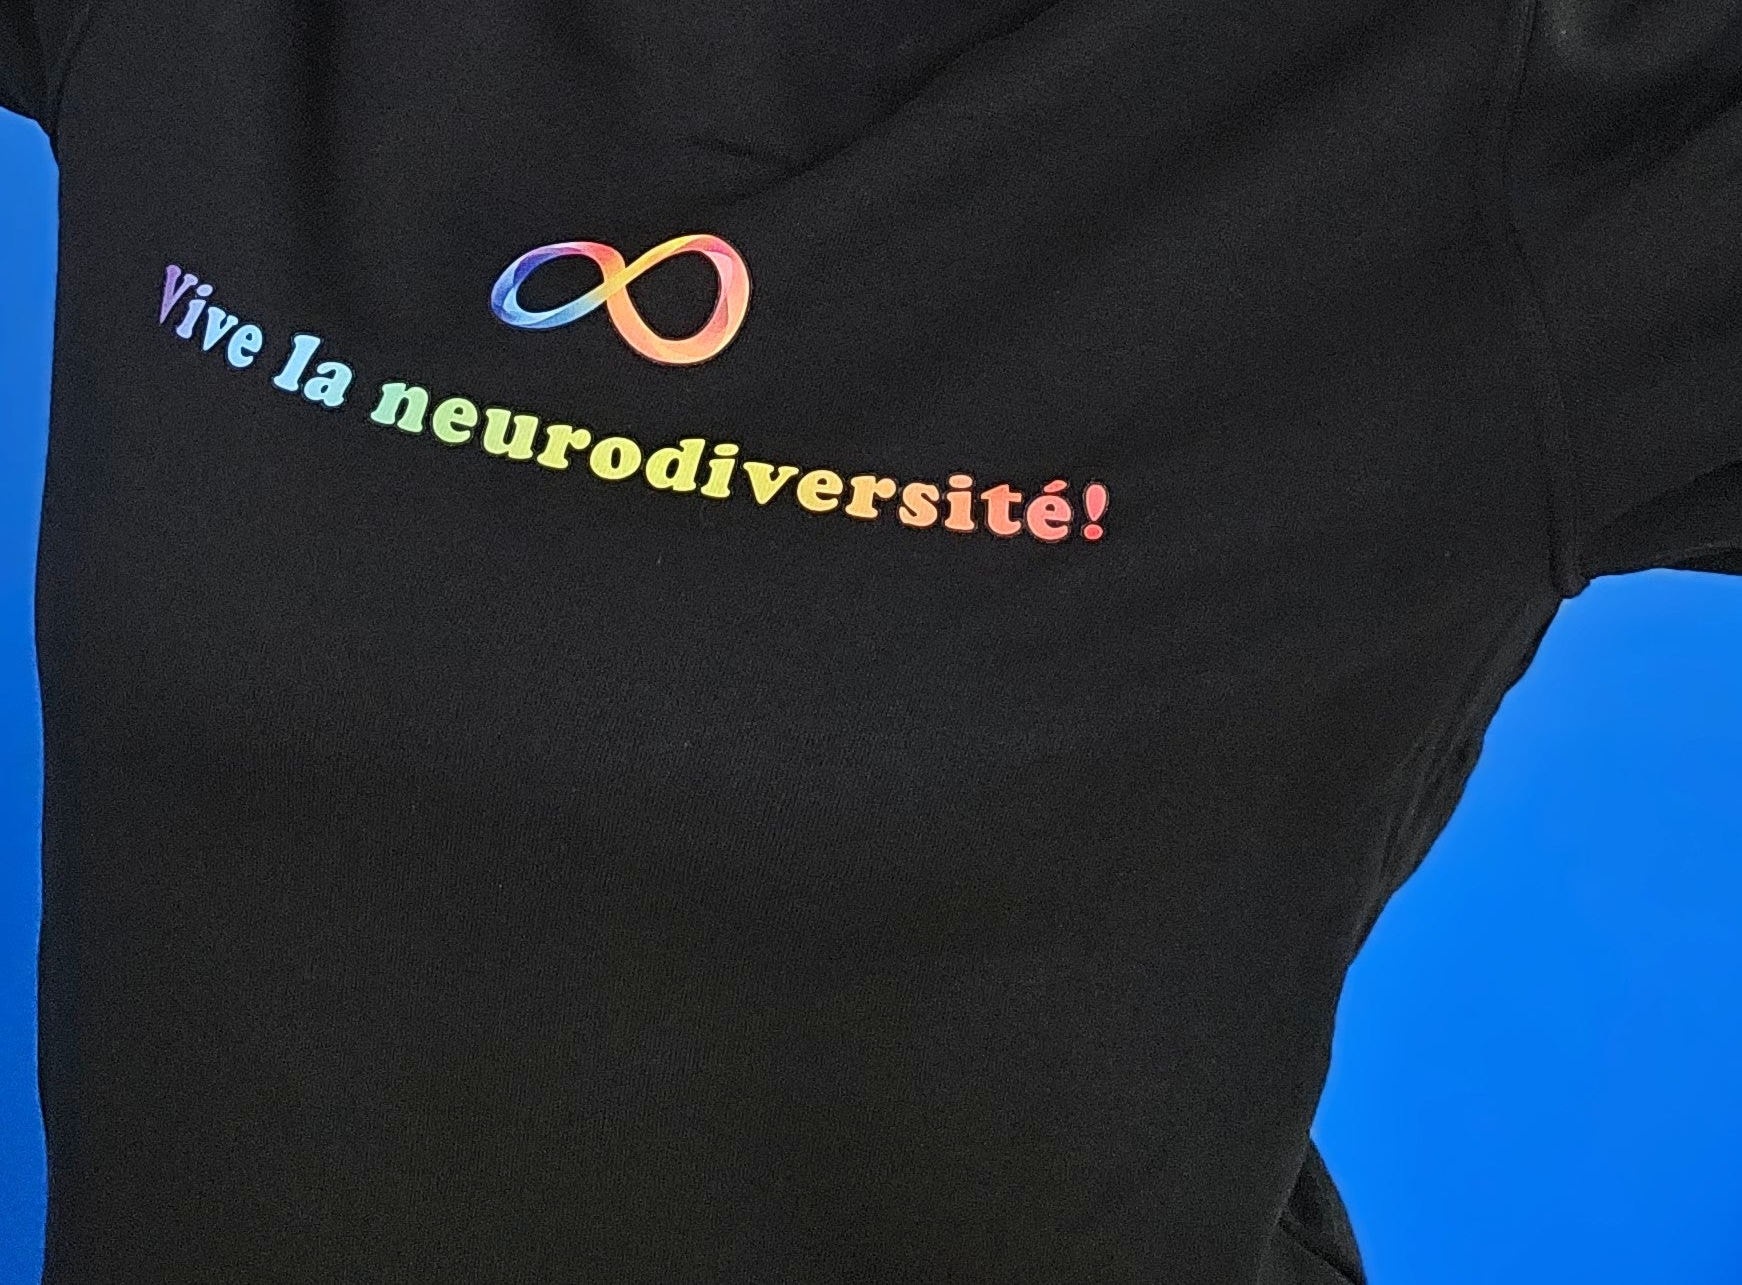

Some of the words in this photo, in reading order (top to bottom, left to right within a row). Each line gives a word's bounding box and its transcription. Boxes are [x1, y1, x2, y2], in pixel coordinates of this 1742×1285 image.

[159, 264, 264, 369] Vive
[271, 334, 354, 408] la
[369, 382, 1110, 544] neurodiversité!
